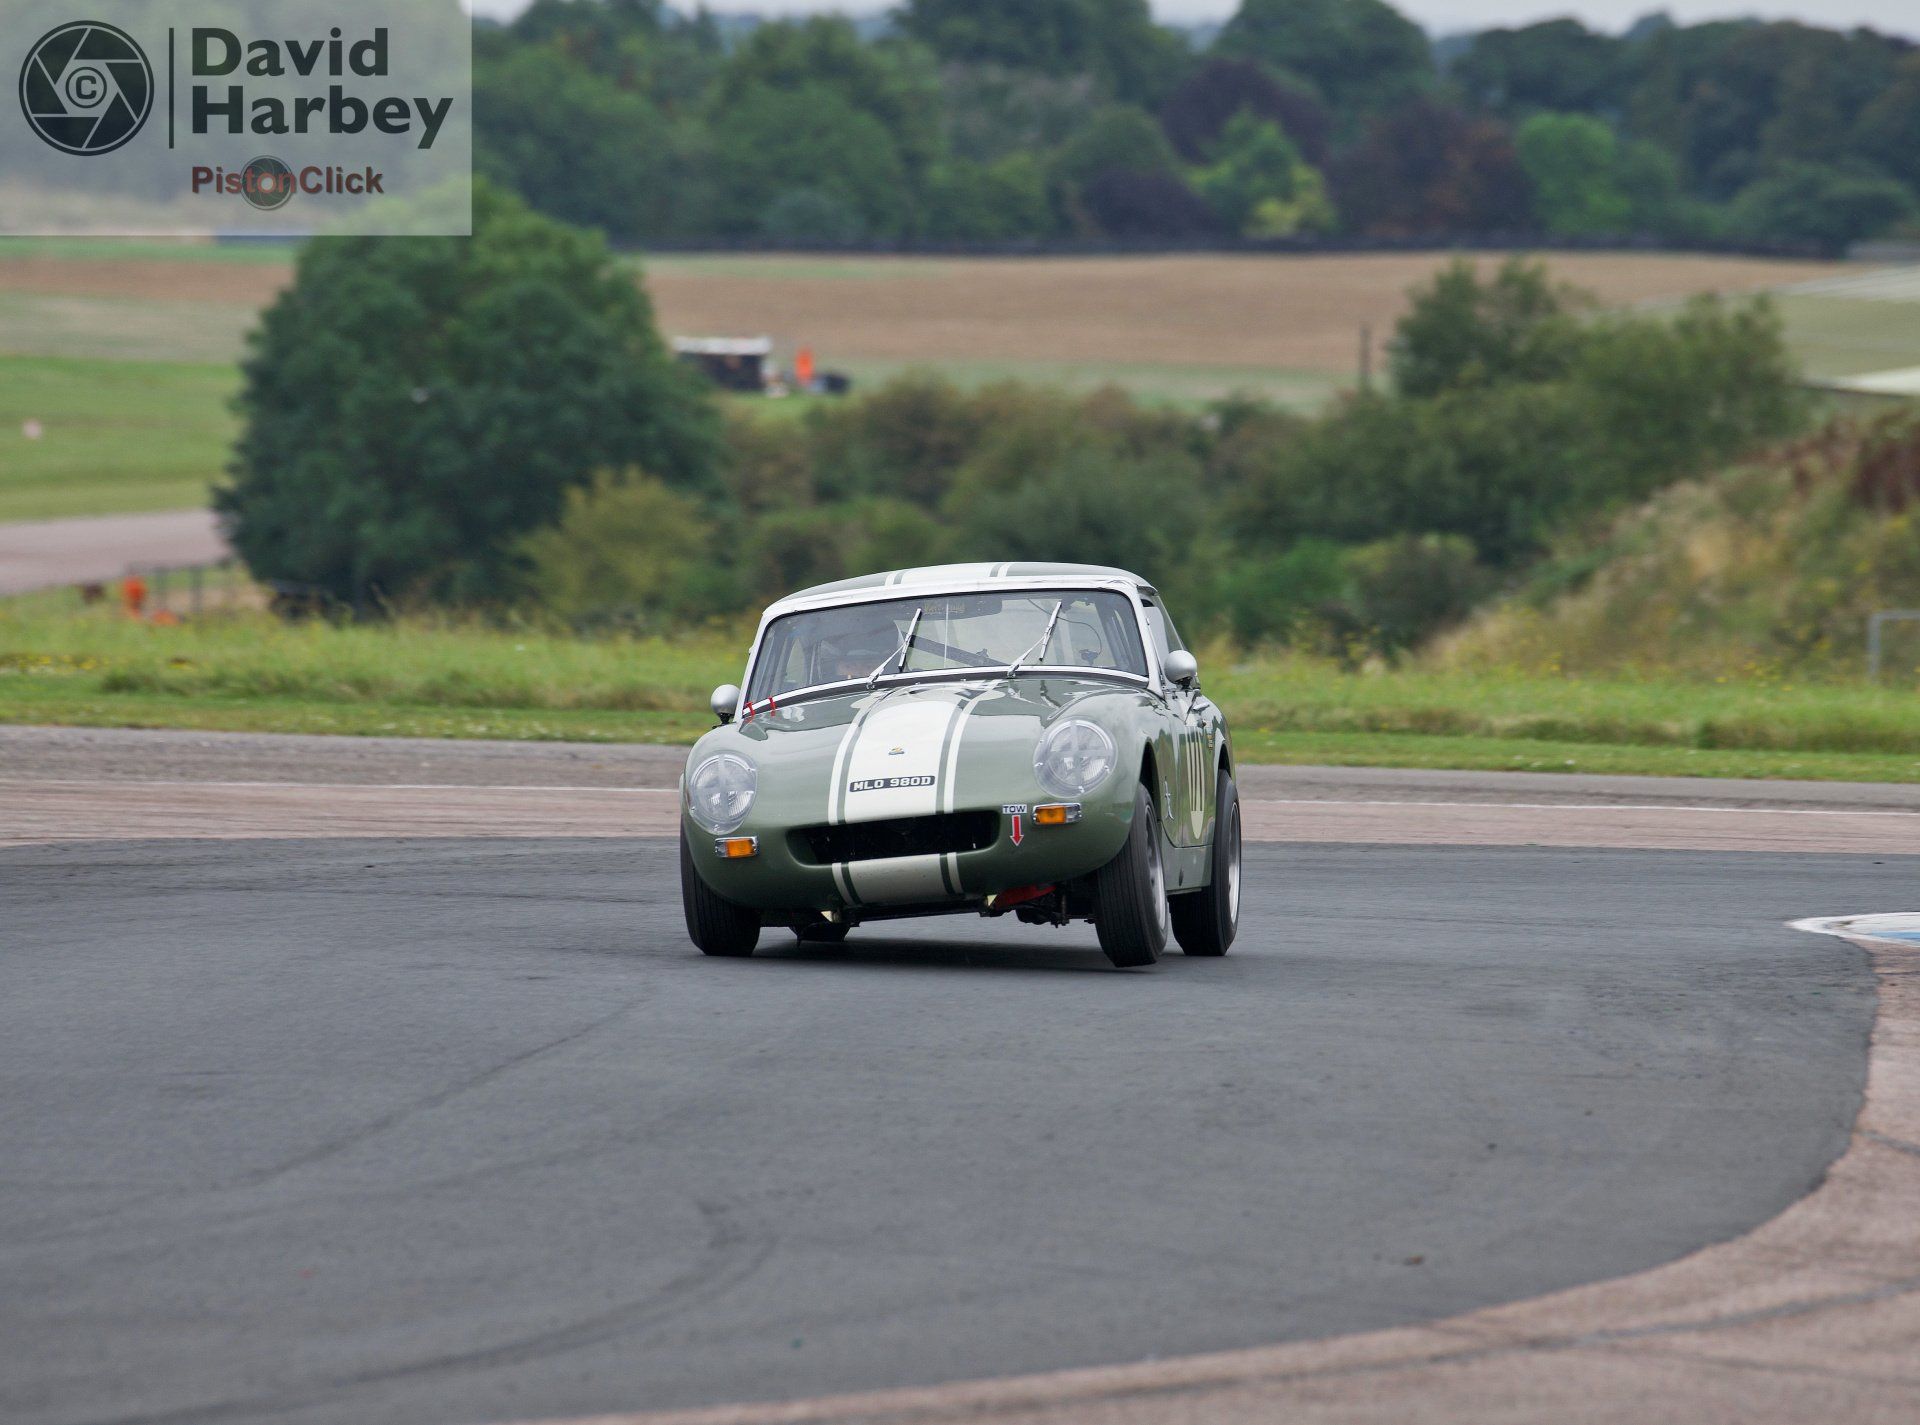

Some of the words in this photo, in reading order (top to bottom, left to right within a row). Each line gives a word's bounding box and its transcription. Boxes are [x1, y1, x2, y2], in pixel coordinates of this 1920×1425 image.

[853, 779, 884, 791] MLO
[890, 776, 931, 787] 980D
[1003, 805, 1026, 813] TOW
